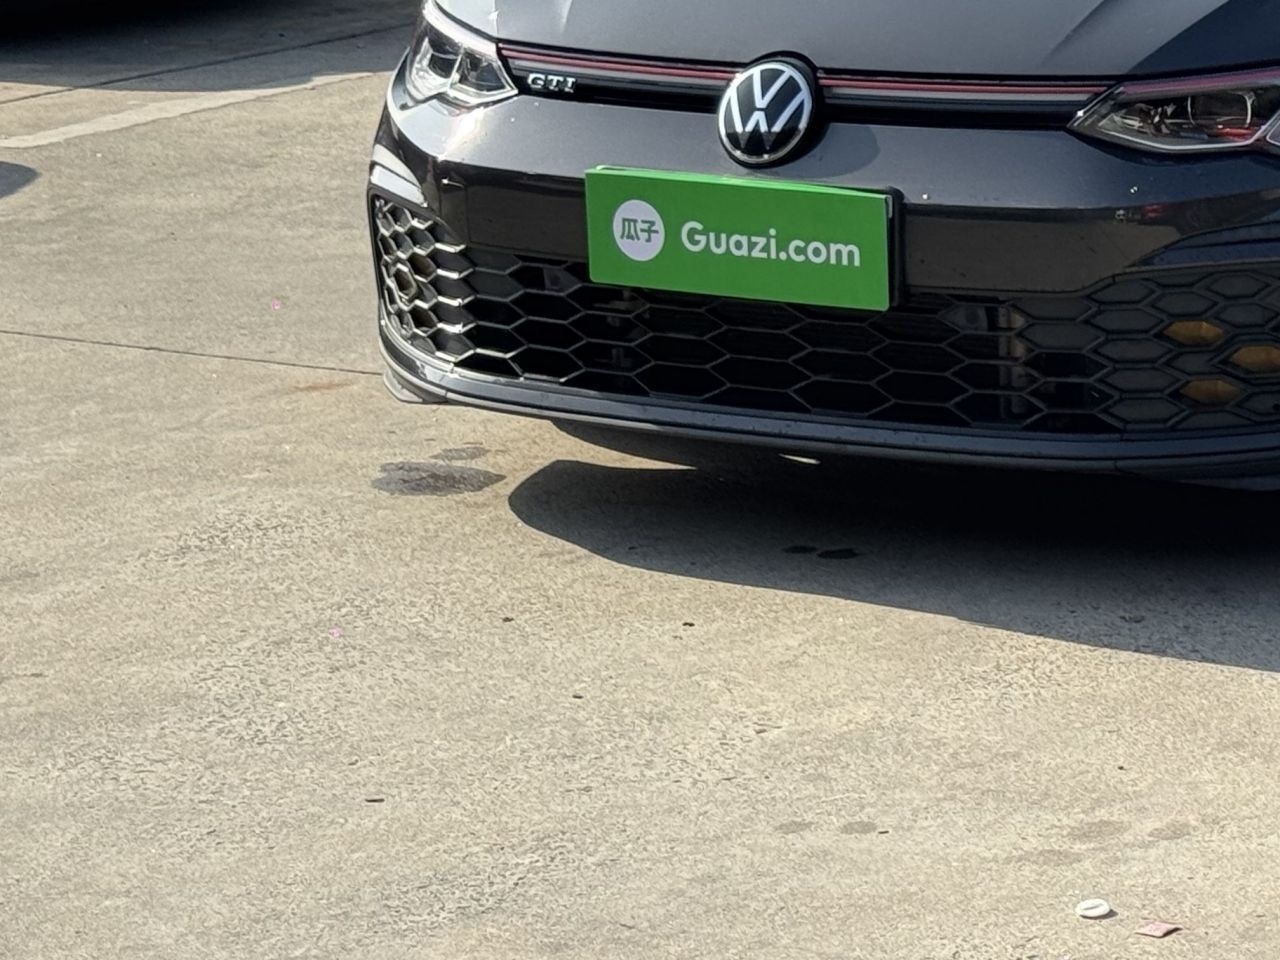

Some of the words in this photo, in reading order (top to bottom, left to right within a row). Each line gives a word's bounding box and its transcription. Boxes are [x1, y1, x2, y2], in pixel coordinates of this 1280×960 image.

[527, 72, 577, 93] GTI
[619, 217, 660, 243] 瓜子
[680, 220, 861, 268] Guazi.com
